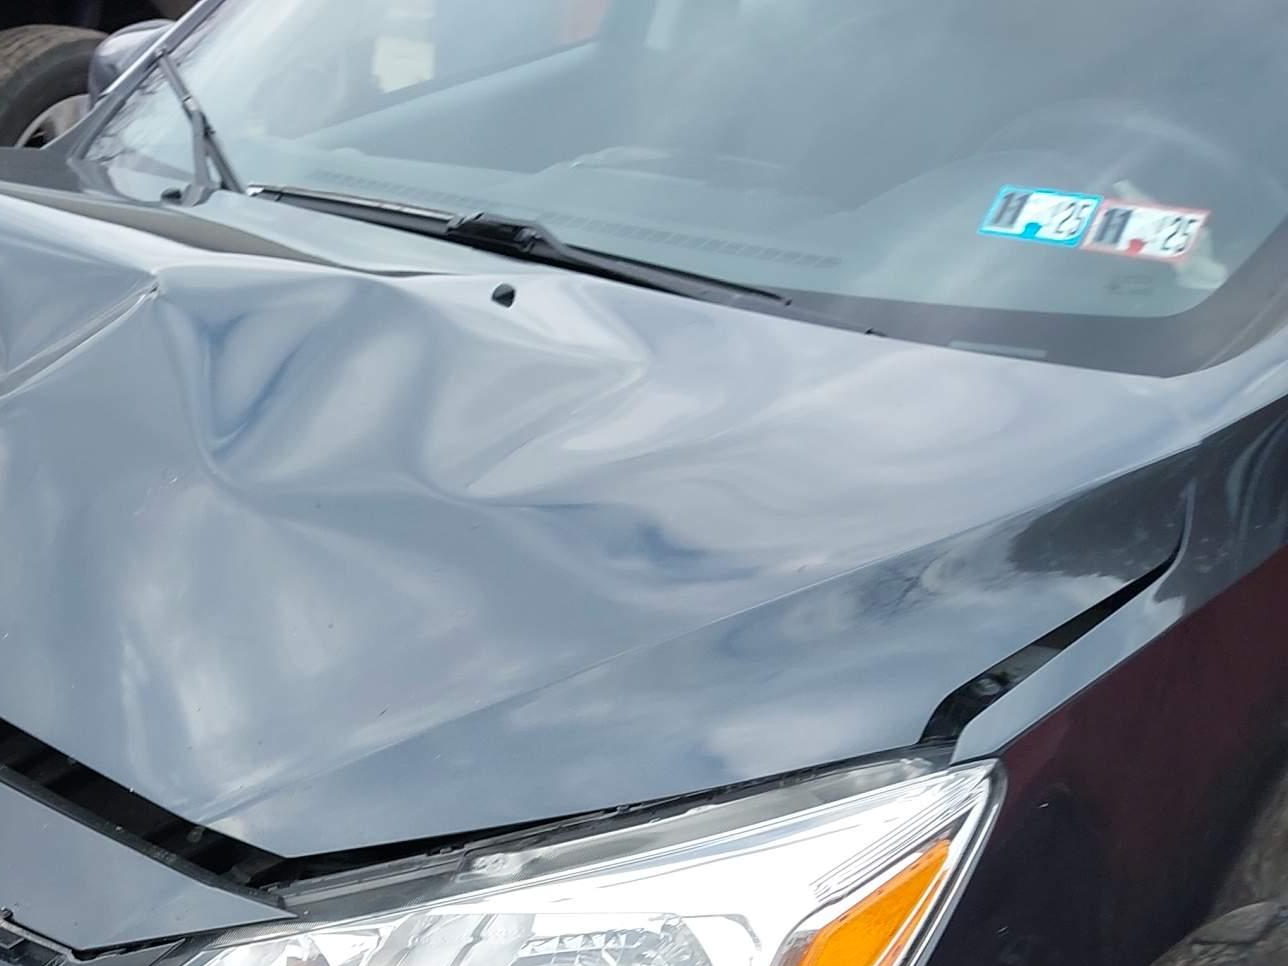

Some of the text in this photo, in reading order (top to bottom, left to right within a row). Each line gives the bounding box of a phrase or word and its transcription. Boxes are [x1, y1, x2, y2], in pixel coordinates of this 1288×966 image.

[993, 191, 1092, 236] 11 25
[1094, 207, 1198, 253] 11 25
